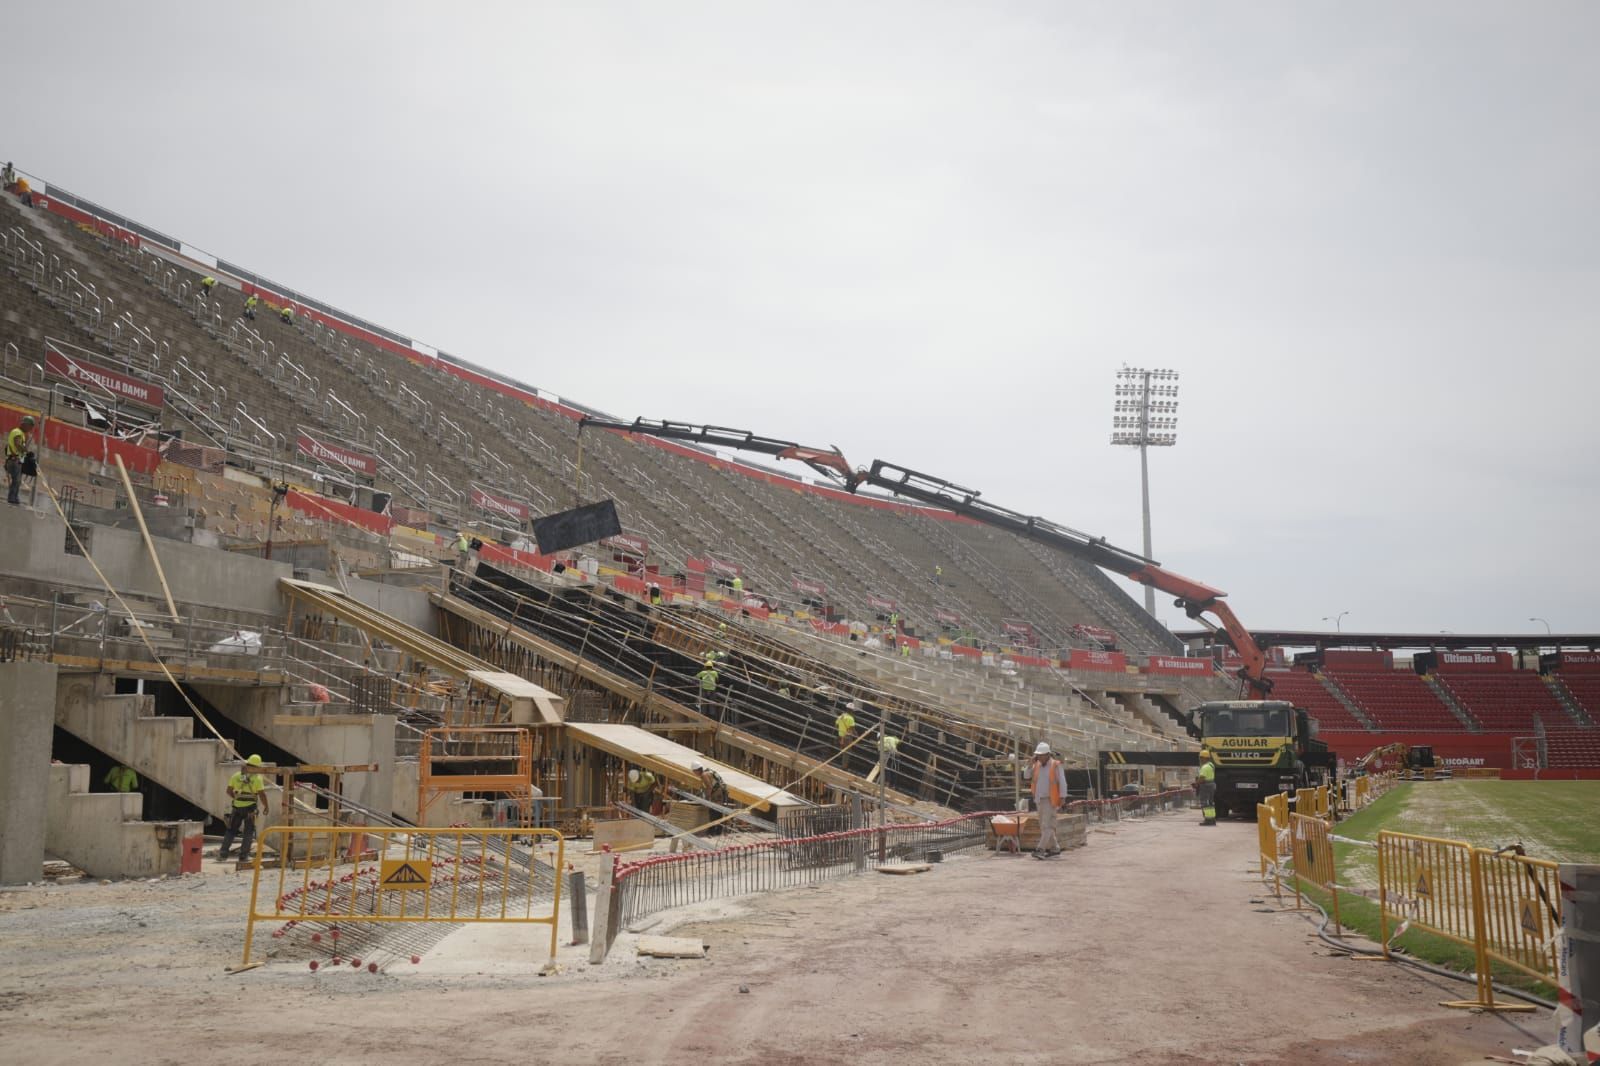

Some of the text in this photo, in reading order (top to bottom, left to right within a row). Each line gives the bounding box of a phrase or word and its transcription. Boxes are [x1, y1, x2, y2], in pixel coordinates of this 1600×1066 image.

[80, 370, 148, 400] ESTRELLA DAMM
[1474, 653, 1496, 663] Hora
[1222, 739, 1268, 747] AGUILAR
